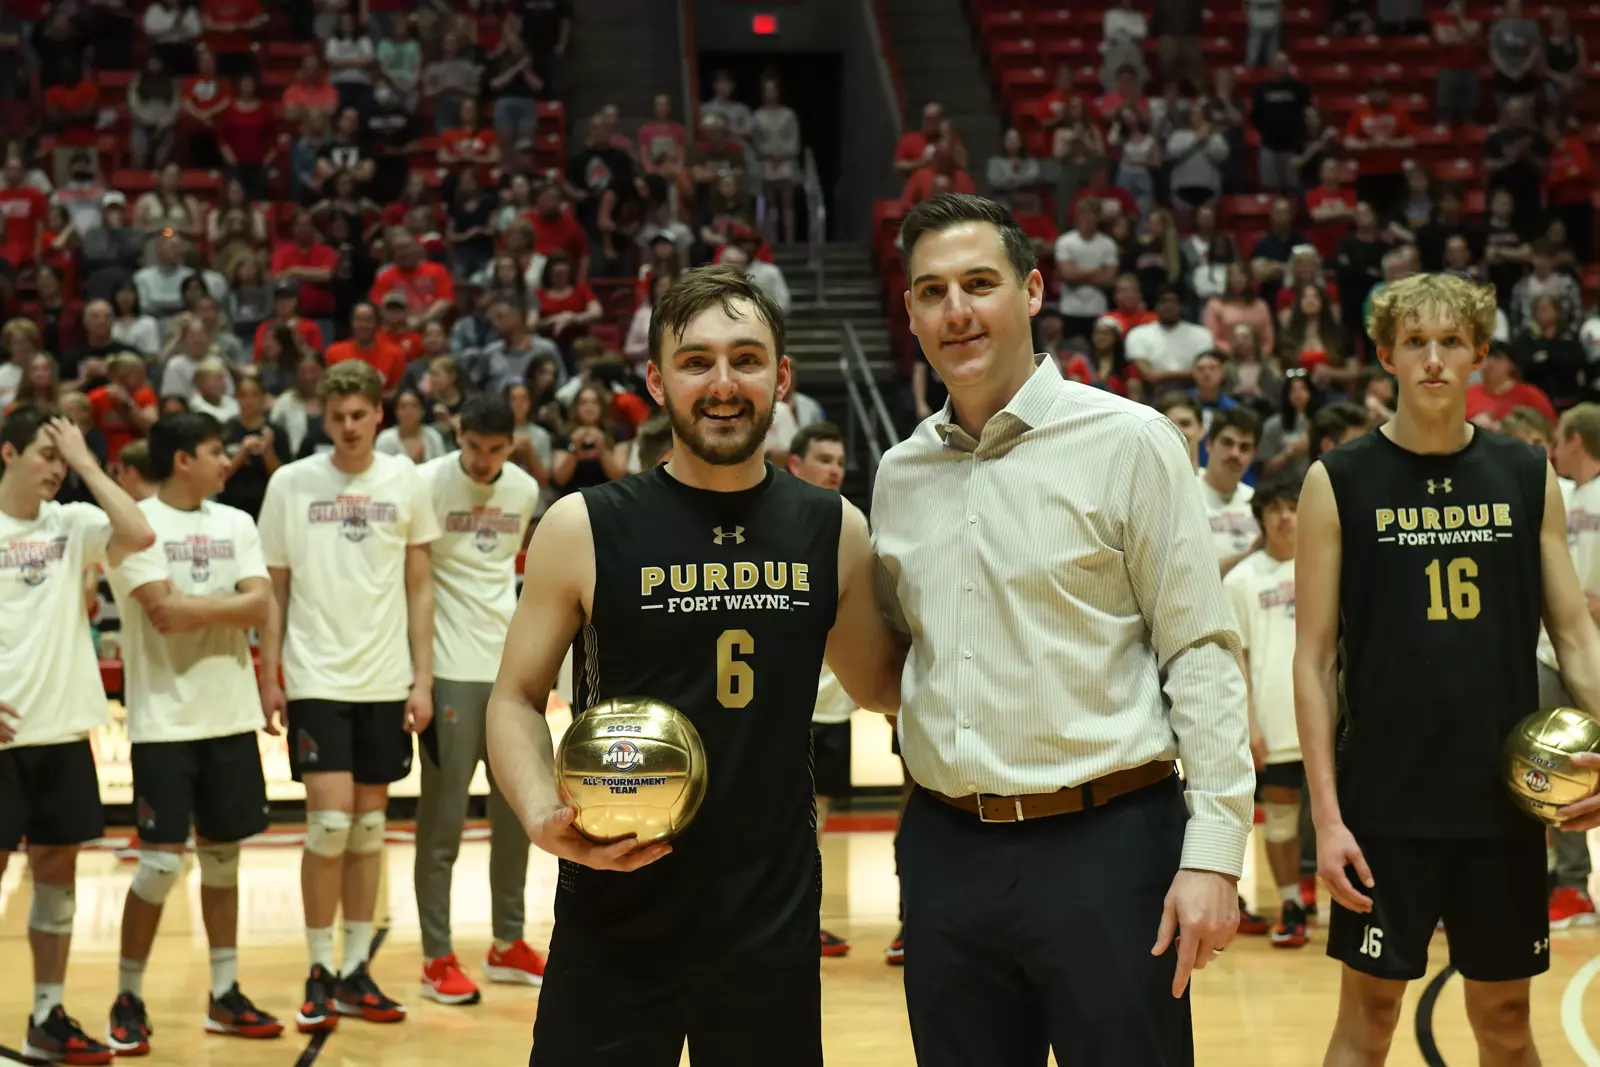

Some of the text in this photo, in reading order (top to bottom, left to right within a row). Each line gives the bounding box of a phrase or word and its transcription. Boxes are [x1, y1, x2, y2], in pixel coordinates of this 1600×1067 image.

[1375, 503, 1513, 532] PURDUE
[1397, 529, 1493, 546] FORT WAYNE
[641, 561, 810, 596] PURDUE
[1425, 556, 1481, 621] 16
[667, 594, 790, 613] FORT WAYNE
[716, 629, 755, 709] 6
[607, 724, 642, 733] 2022
[602, 750, 645, 766] MIVA
[582, 777, 667, 786] ALL-TOURNAMENT
[609, 786, 638, 794] TEAM
[1521, 771, 1553, 793] MIVA
[1359, 924, 1384, 959] 16
